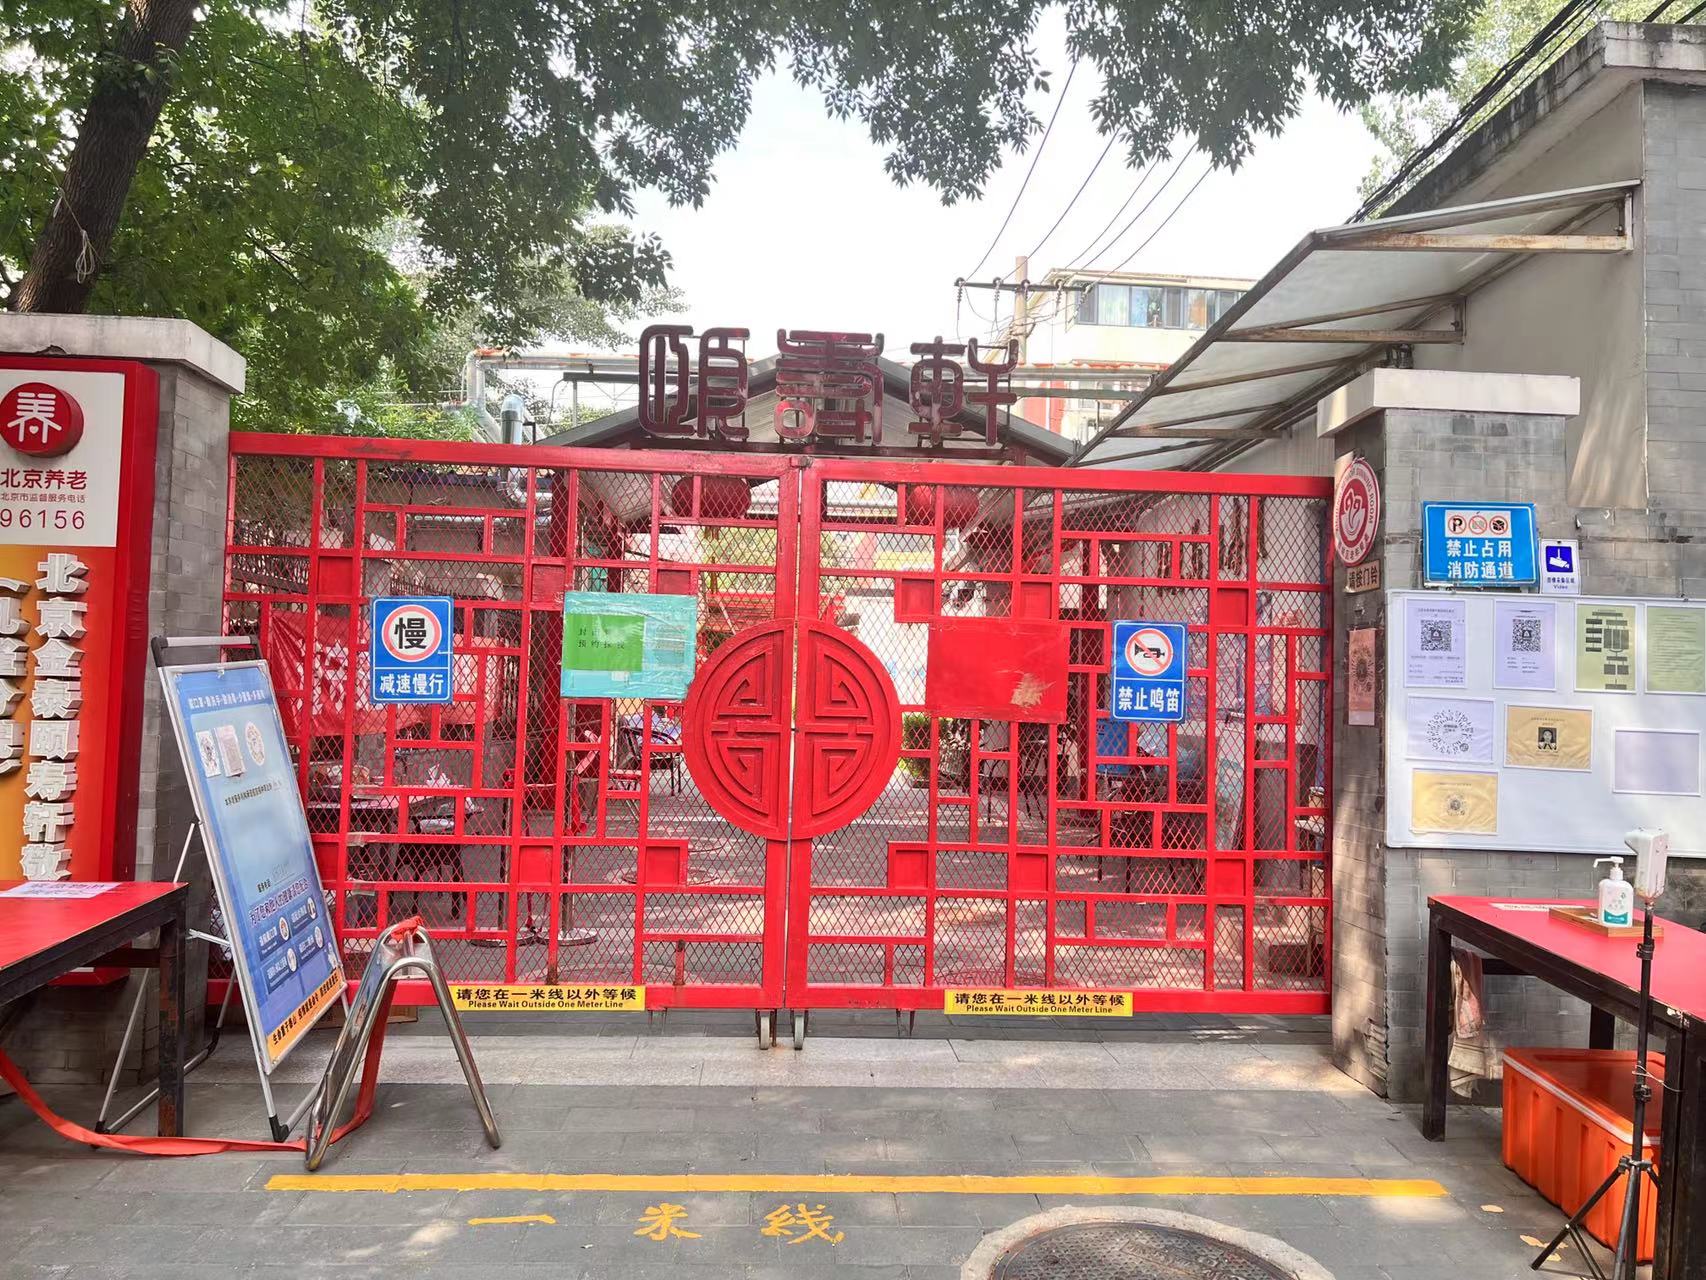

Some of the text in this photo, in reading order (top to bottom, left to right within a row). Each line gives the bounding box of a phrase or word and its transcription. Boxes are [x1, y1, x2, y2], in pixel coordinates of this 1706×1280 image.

[0, 468, 87, 490] 北京养老
[1, 492, 86, 504] 北京市监督服务电话
[0, 508, 85, 530] 96156
[1446, 539, 1513, 558] 禁止占用
[1447, 561, 1514, 579] 消防通道
[394, 617, 427, 650] 慢
[380, 673, 444, 695] 减速慢行
[1118, 686, 1180, 713] 禁止鸣笛
[456, 988, 636, 1000] 请您在一米线以外等候
[955, 993, 1125, 1006] 请您在一米线以外等候
[468, 1000, 623, 1008] Please Wait Outside One Meter Line
[966, 1004, 1113, 1014] Please Wait Outside One Meter Line
